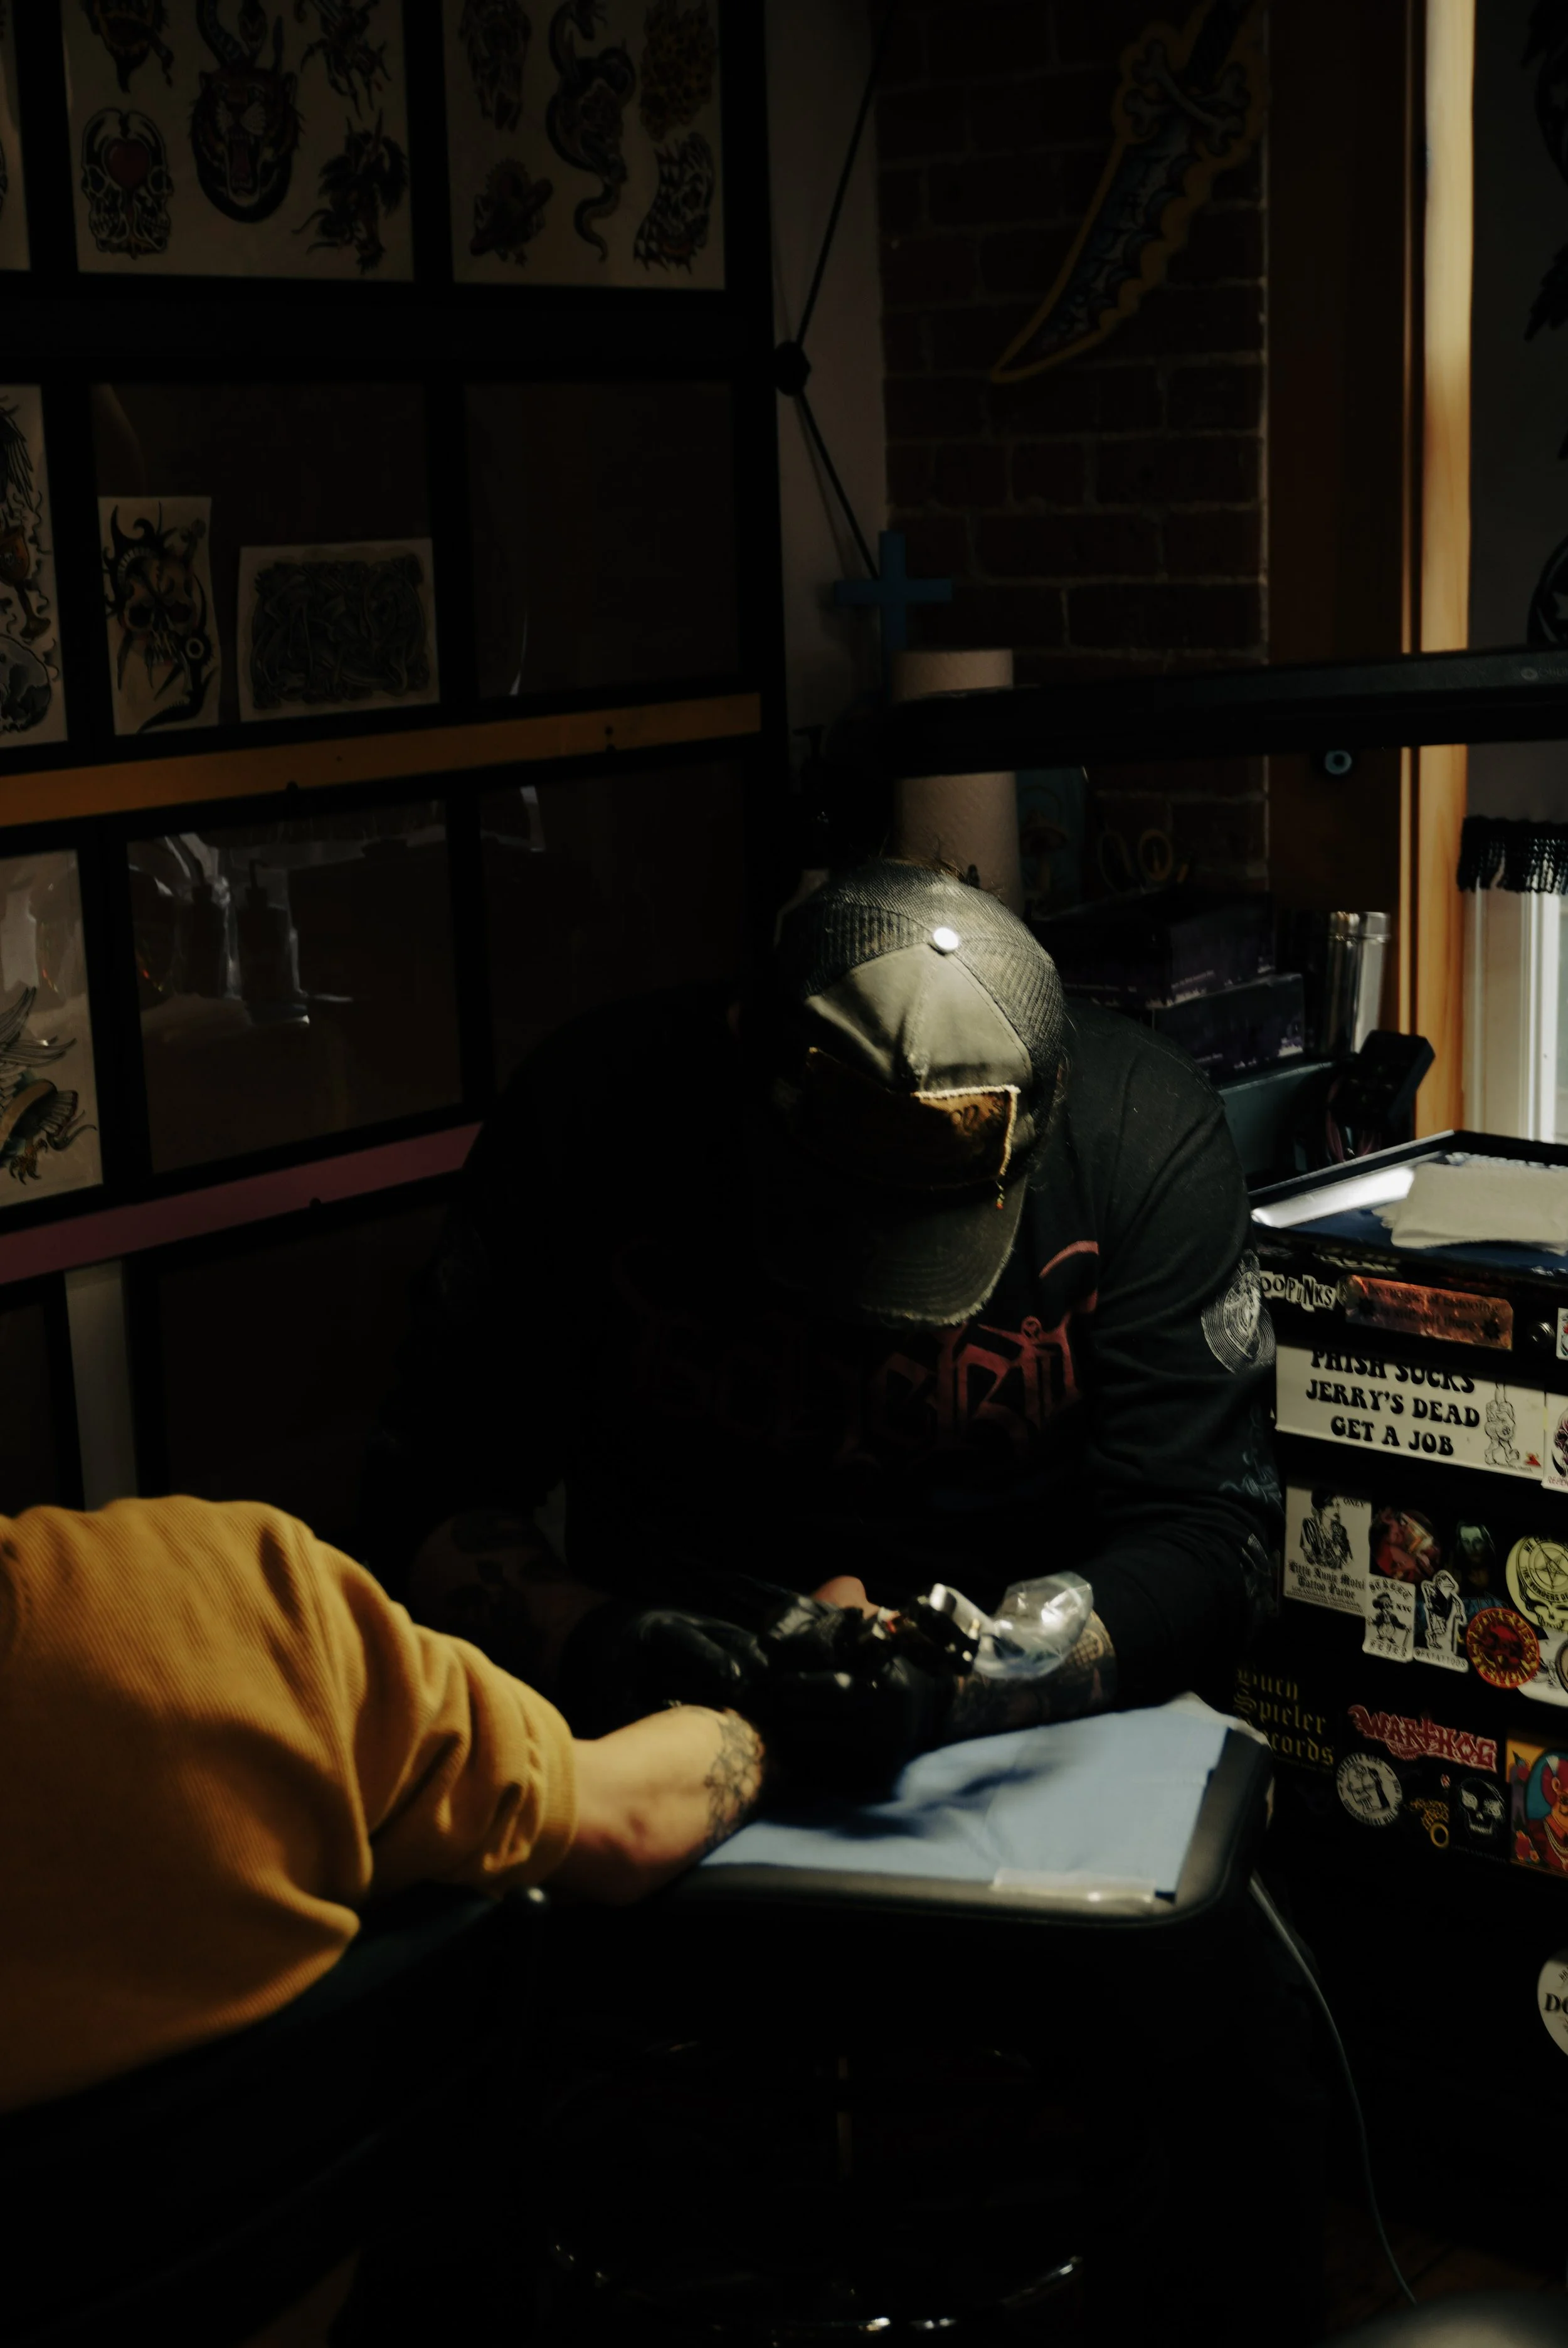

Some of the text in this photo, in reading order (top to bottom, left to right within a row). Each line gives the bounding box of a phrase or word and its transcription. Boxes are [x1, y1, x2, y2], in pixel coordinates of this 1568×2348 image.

[1311, 1349, 1475, 1393] PHISH SUCKS
[1306, 1379, 1480, 1427] JERRY'S DEAD
[1330, 1416, 1454, 1455] GET A JOB
[1233, 1687, 1327, 1736] Spieler
[1263, 1729, 1335, 1767] cords
[1347, 1704, 1498, 1774] WARTHOG
